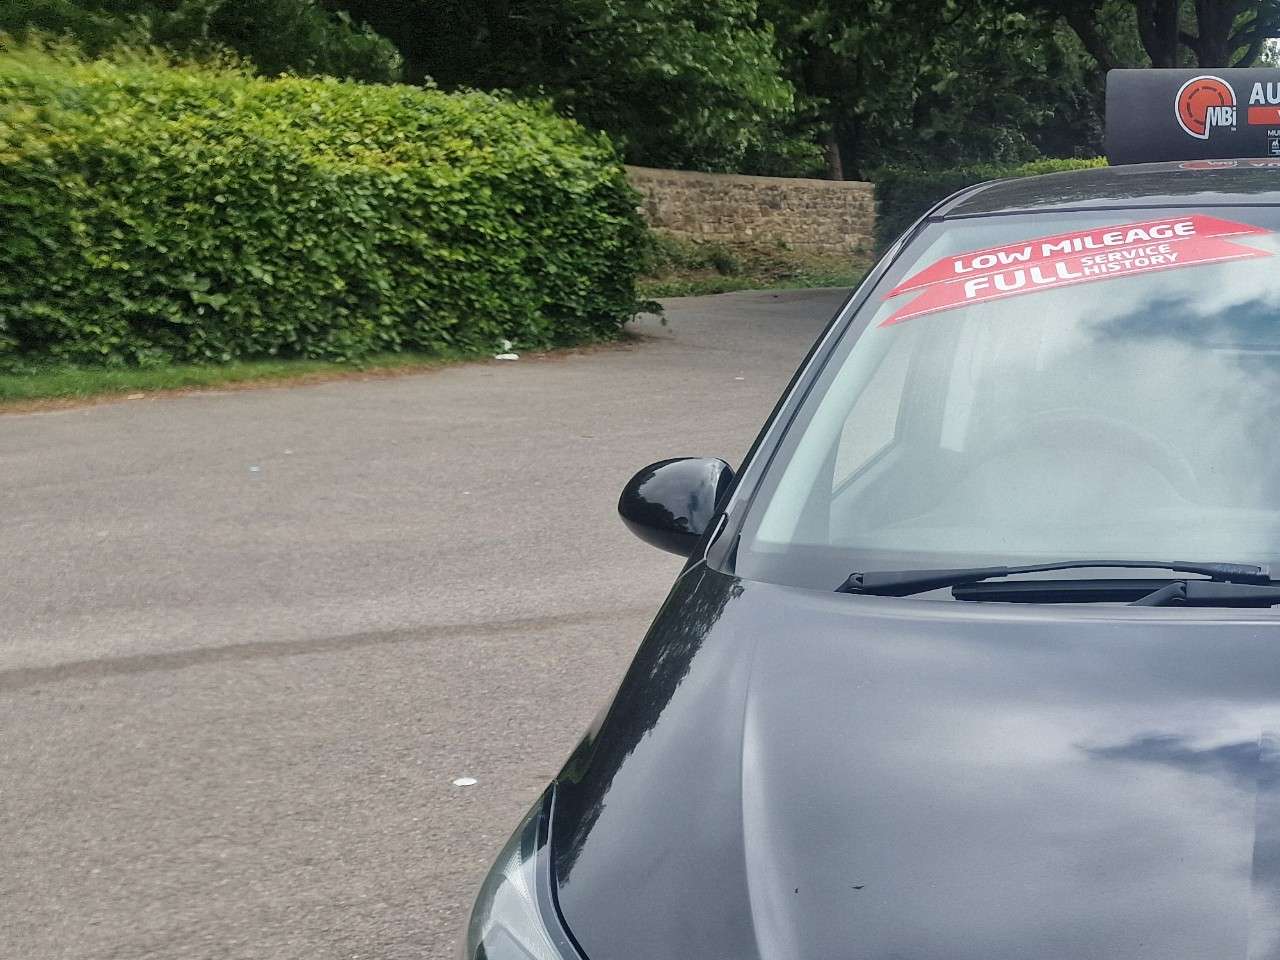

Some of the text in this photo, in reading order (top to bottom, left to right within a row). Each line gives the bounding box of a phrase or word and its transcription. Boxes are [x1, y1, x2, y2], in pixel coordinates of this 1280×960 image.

[1206, 105, 1237, 127] MBi
[955, 222, 1194, 273] LOW MILEAGE
[1082, 243, 1172, 267] SERVICE
[1085, 252, 1179, 276] HISTORY
[964, 260, 1083, 298] FULL
